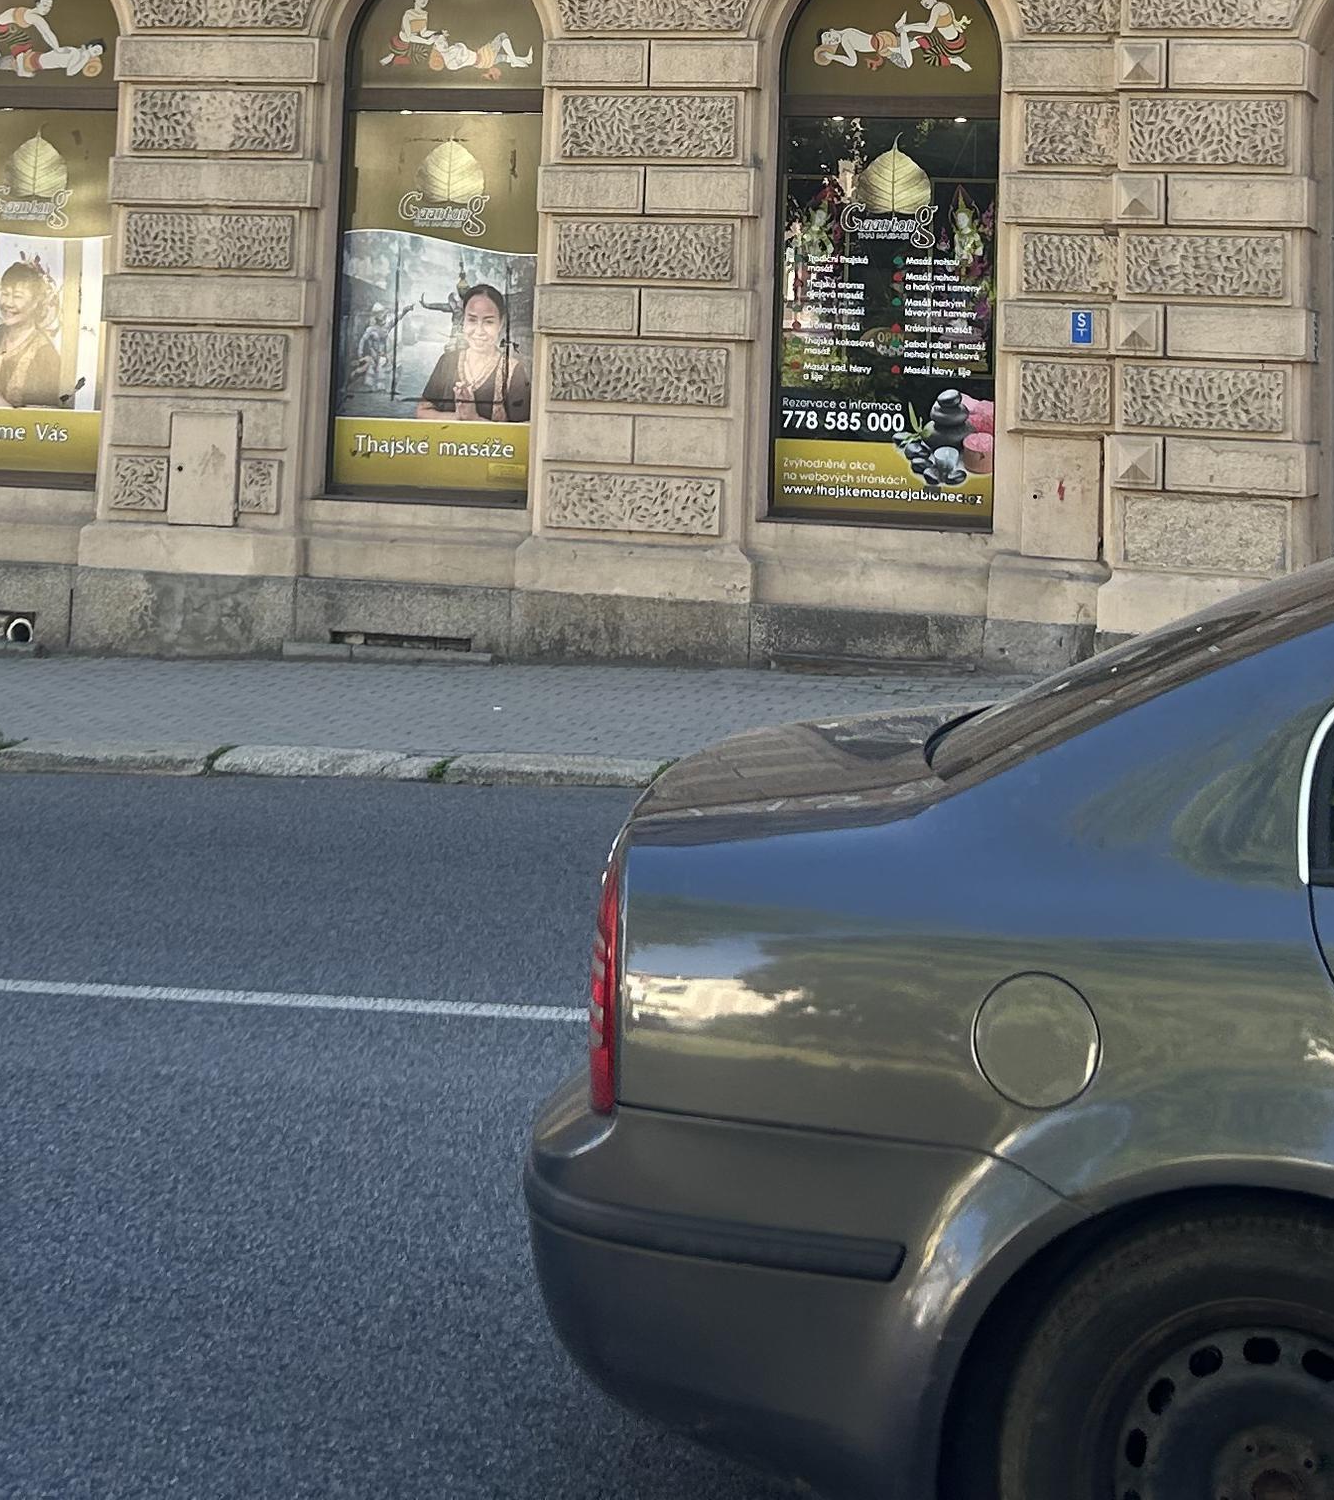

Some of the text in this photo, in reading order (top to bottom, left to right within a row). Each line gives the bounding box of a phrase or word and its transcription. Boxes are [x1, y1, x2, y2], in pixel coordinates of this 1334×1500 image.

[906, 256, 932, 266] Masáž
[905, 272, 932, 281] Masáž
[904, 298, 931, 307] Masáž
[1077, 313, 1087, 328] S
[903, 366, 930, 375] Masáž
[782, 397, 902, 411] Rezervace a informace
[782, 410, 905, 432] 778 585 000
[35, 422, 68, 441] Vás
[355, 434, 514, 458] Thajské masáže
[783, 458, 875, 471] Zvýhodněné akce
[783, 471, 907, 486] na webových stránkách
